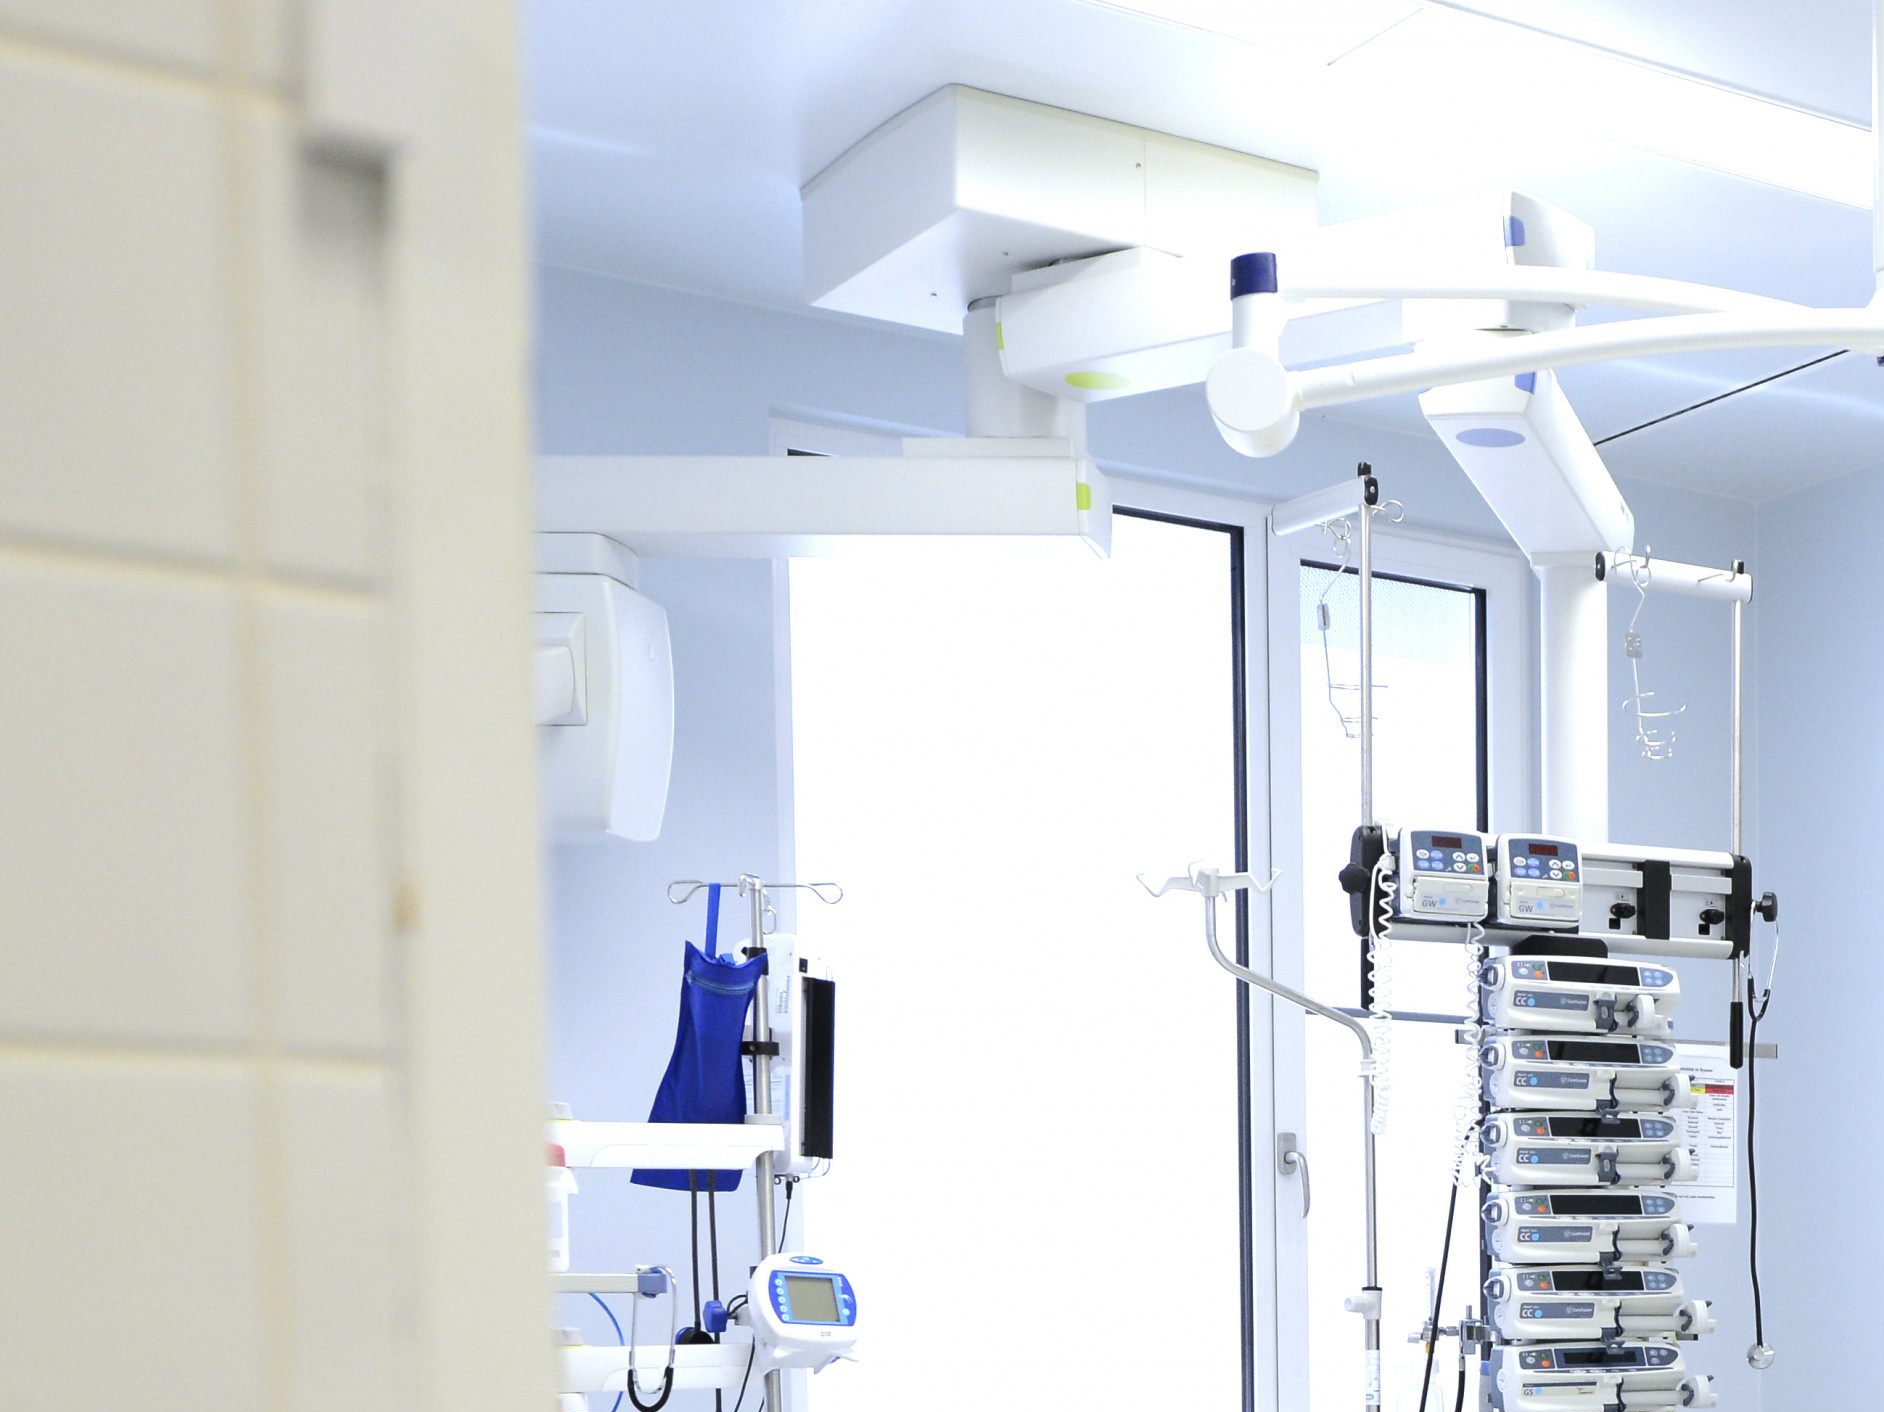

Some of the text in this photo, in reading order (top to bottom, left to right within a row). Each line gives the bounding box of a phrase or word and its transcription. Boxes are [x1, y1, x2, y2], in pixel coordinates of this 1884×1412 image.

[1422, 899, 1437, 908] GW
[1518, 904, 1533, 913] GW
[1515, 997, 1527, 1006] CC
[1516, 1077, 1527, 1086] CC
[1518, 1154, 1530, 1163] CC
[1519, 1232, 1531, 1241] CC
[1522, 1309, 1533, 1318] CC
[1523, 1388, 1534, 1397] GS
